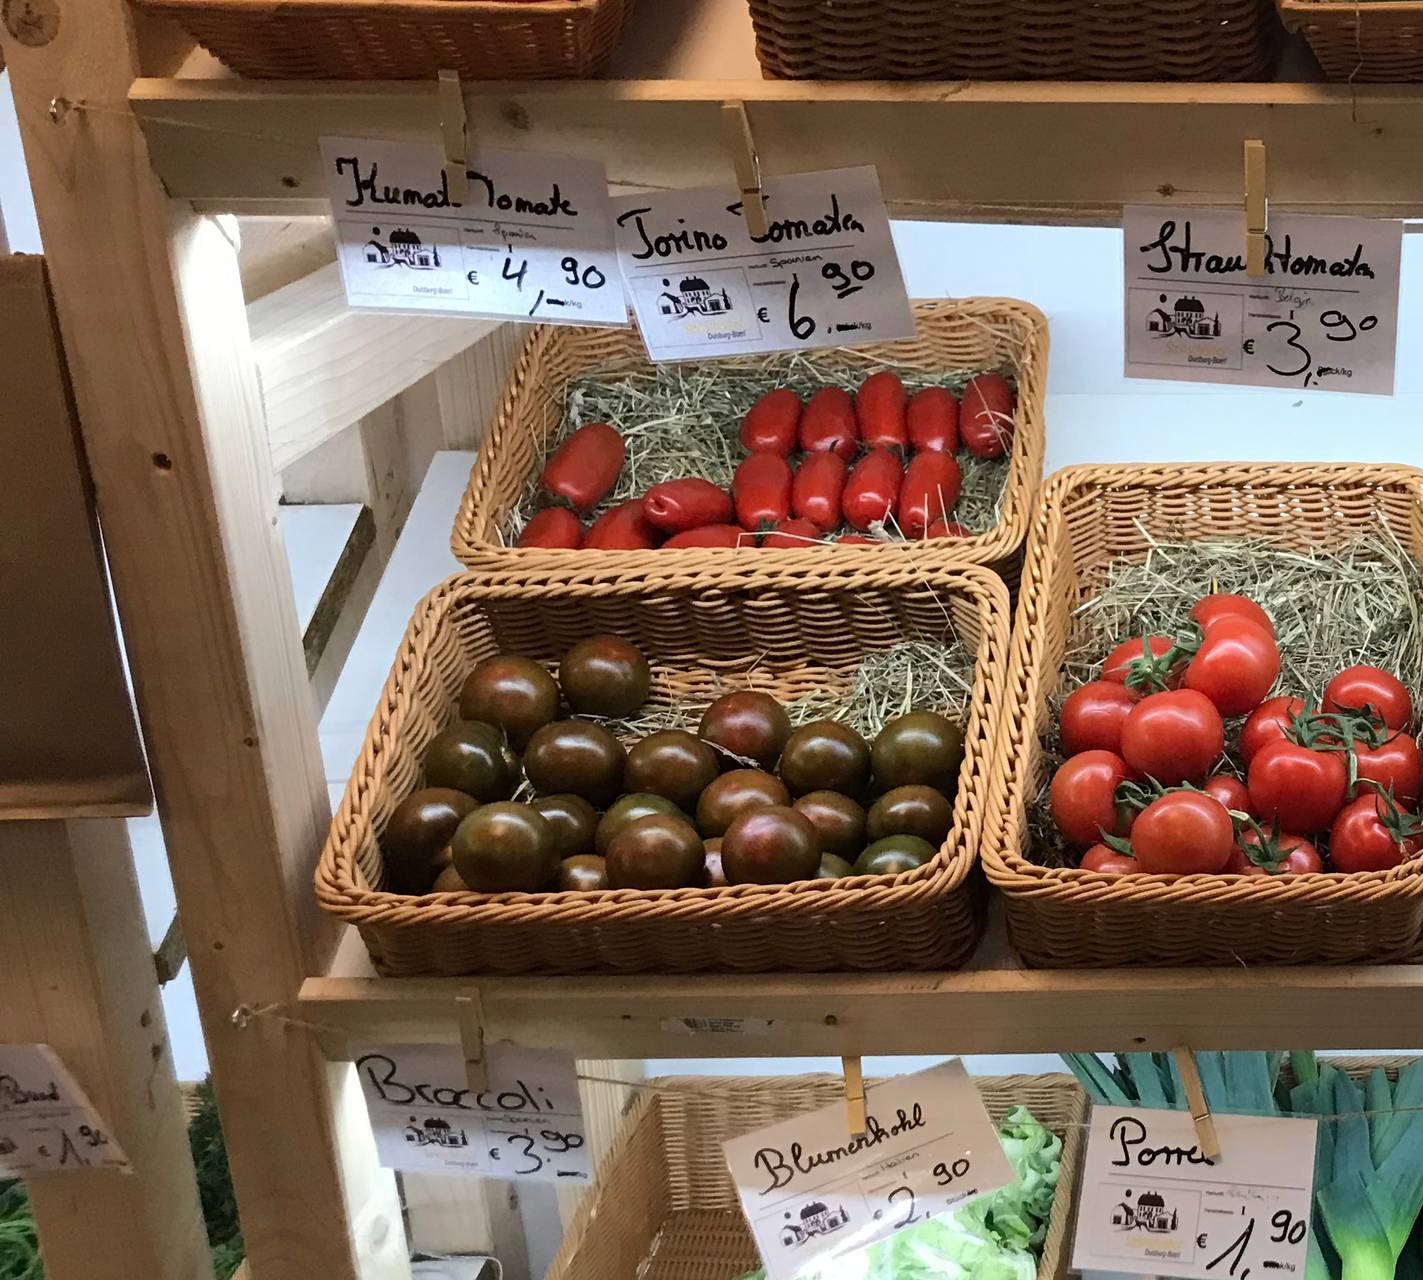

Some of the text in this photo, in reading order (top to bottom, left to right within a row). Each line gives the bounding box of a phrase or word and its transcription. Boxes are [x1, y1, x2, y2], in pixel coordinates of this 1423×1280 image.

[617, 208, 728, 258] Torino
[1140, 221, 1375, 279] Strauhtomaten
[467, 270, 480, 285] €
[758, 307, 770, 322] €
[1242, 339, 1254, 354] €
[356, 1054, 553, 1111] Broccoli
[490, 1148, 500, 1160] €
[754, 1102, 926, 1195] Blumenkohl
[1197, 1233, 1208, 1249] €
